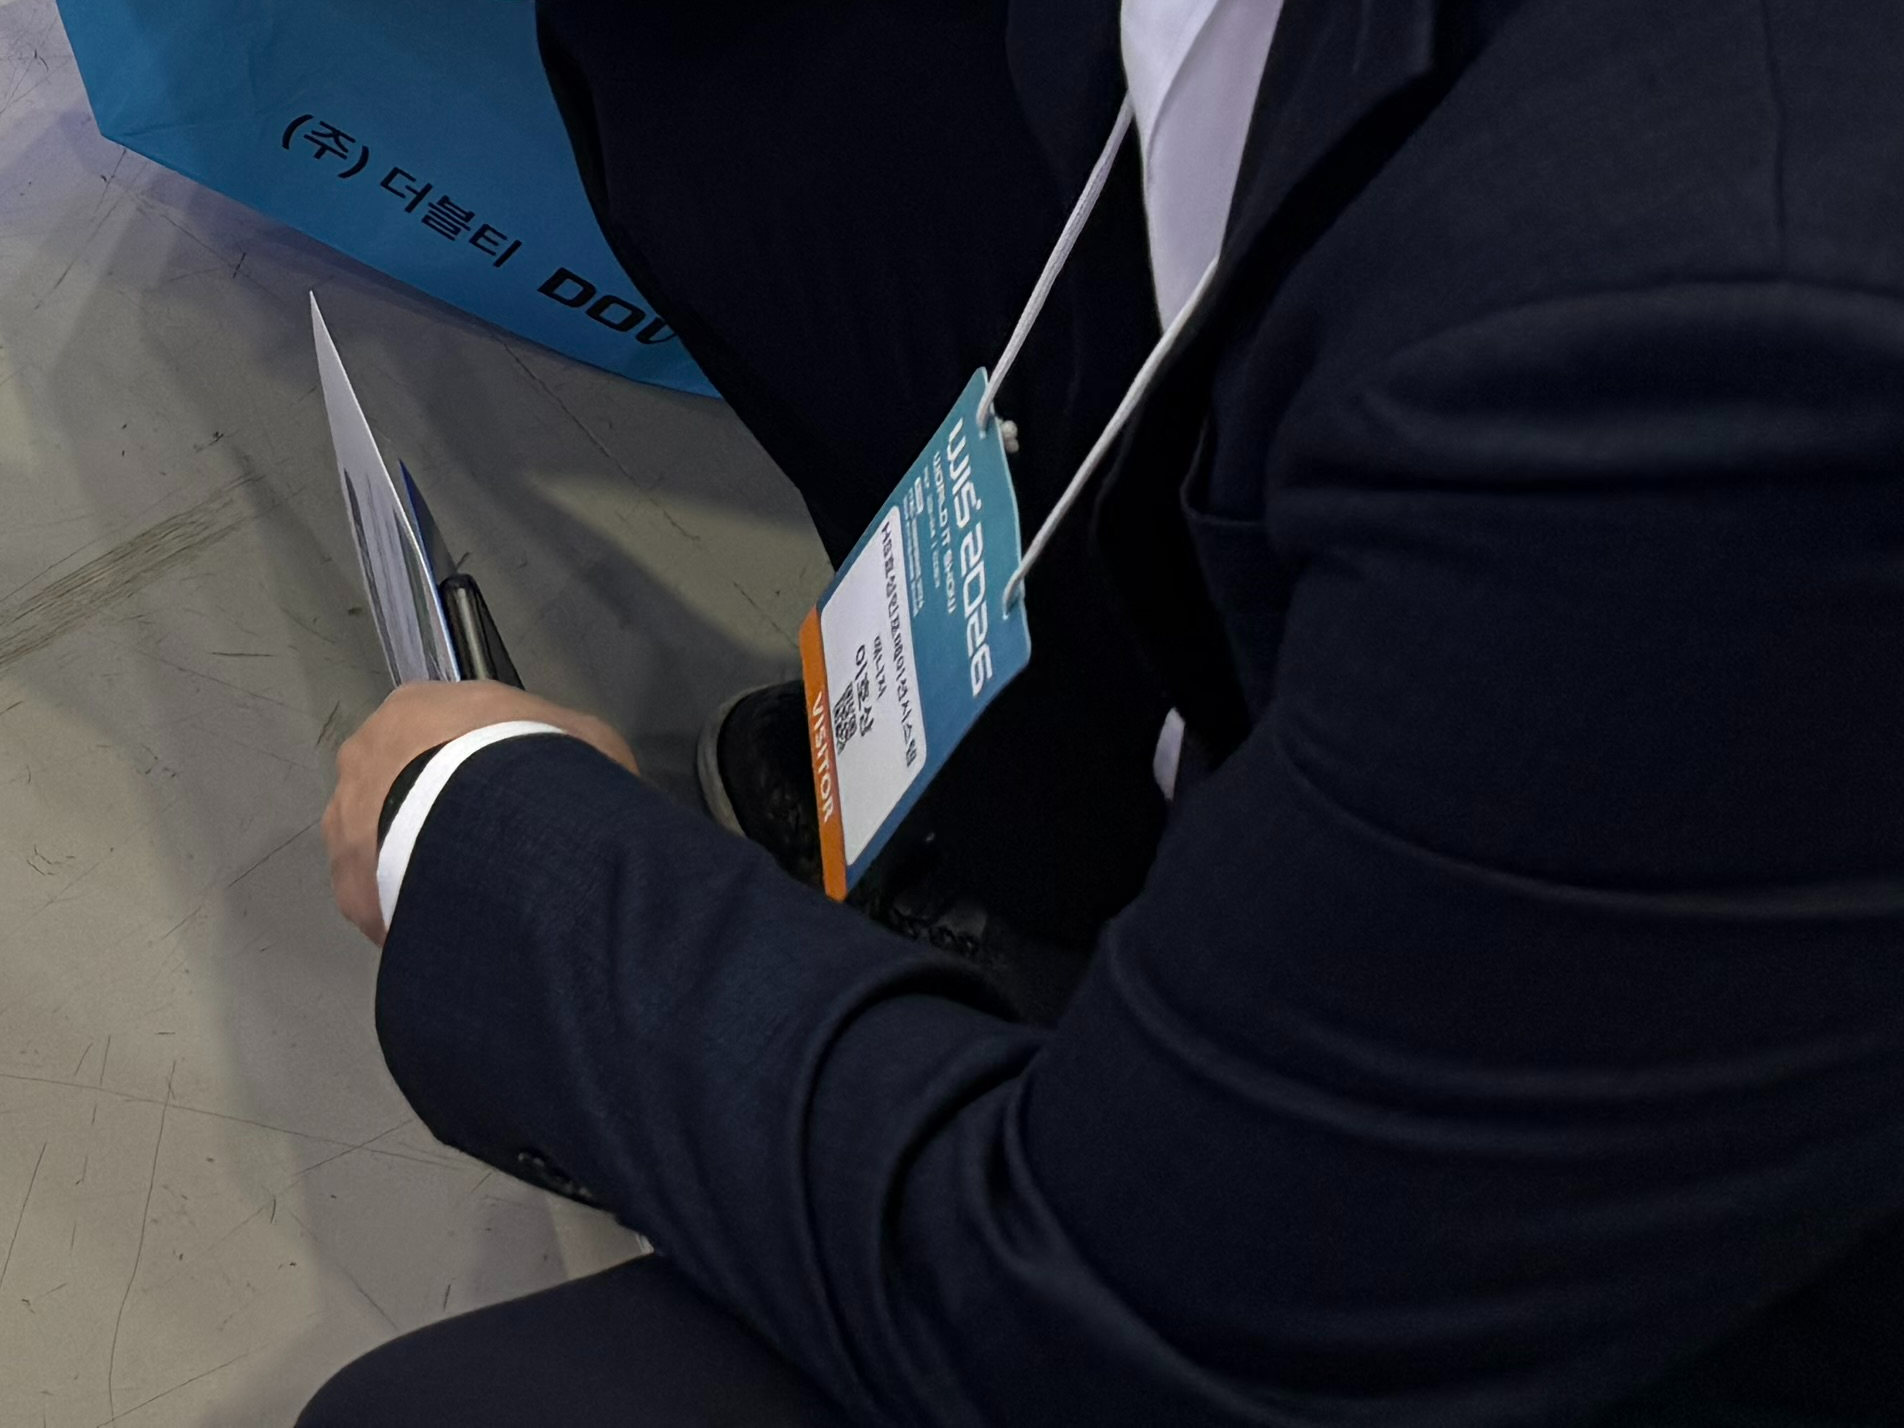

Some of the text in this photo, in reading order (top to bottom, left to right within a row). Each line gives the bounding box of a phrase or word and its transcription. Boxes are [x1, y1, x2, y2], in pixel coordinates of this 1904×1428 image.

[281, 114, 369, 179] (주)
[380, 166, 523, 268] 더블티
[959, 536, 992, 699] 2026
[811, 691, 834, 823] VISITOR
